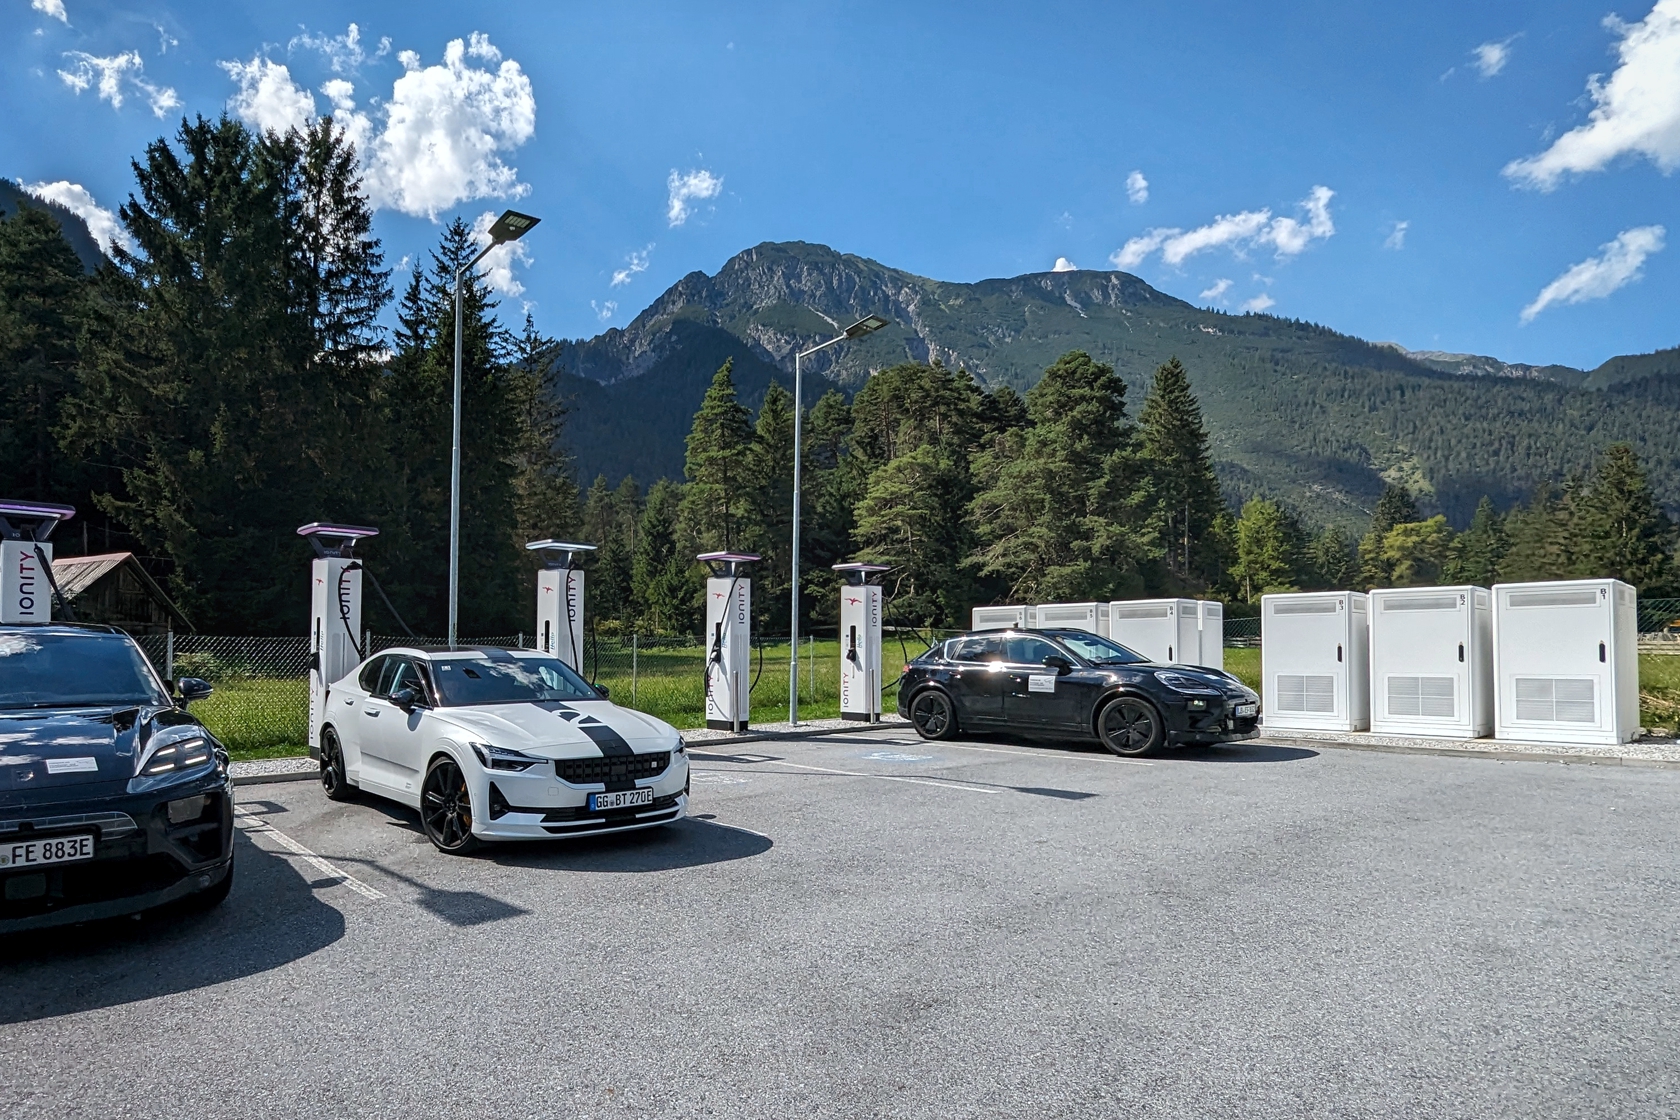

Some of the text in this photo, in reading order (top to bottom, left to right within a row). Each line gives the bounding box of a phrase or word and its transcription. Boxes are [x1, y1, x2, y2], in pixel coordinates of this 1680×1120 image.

[19, 550, 35, 615] IONITY
[568, 576, 577, 622] IONITY
[596, 790, 652, 809] GG BT 270E
[12, 838, 91, 865] FE 883E
